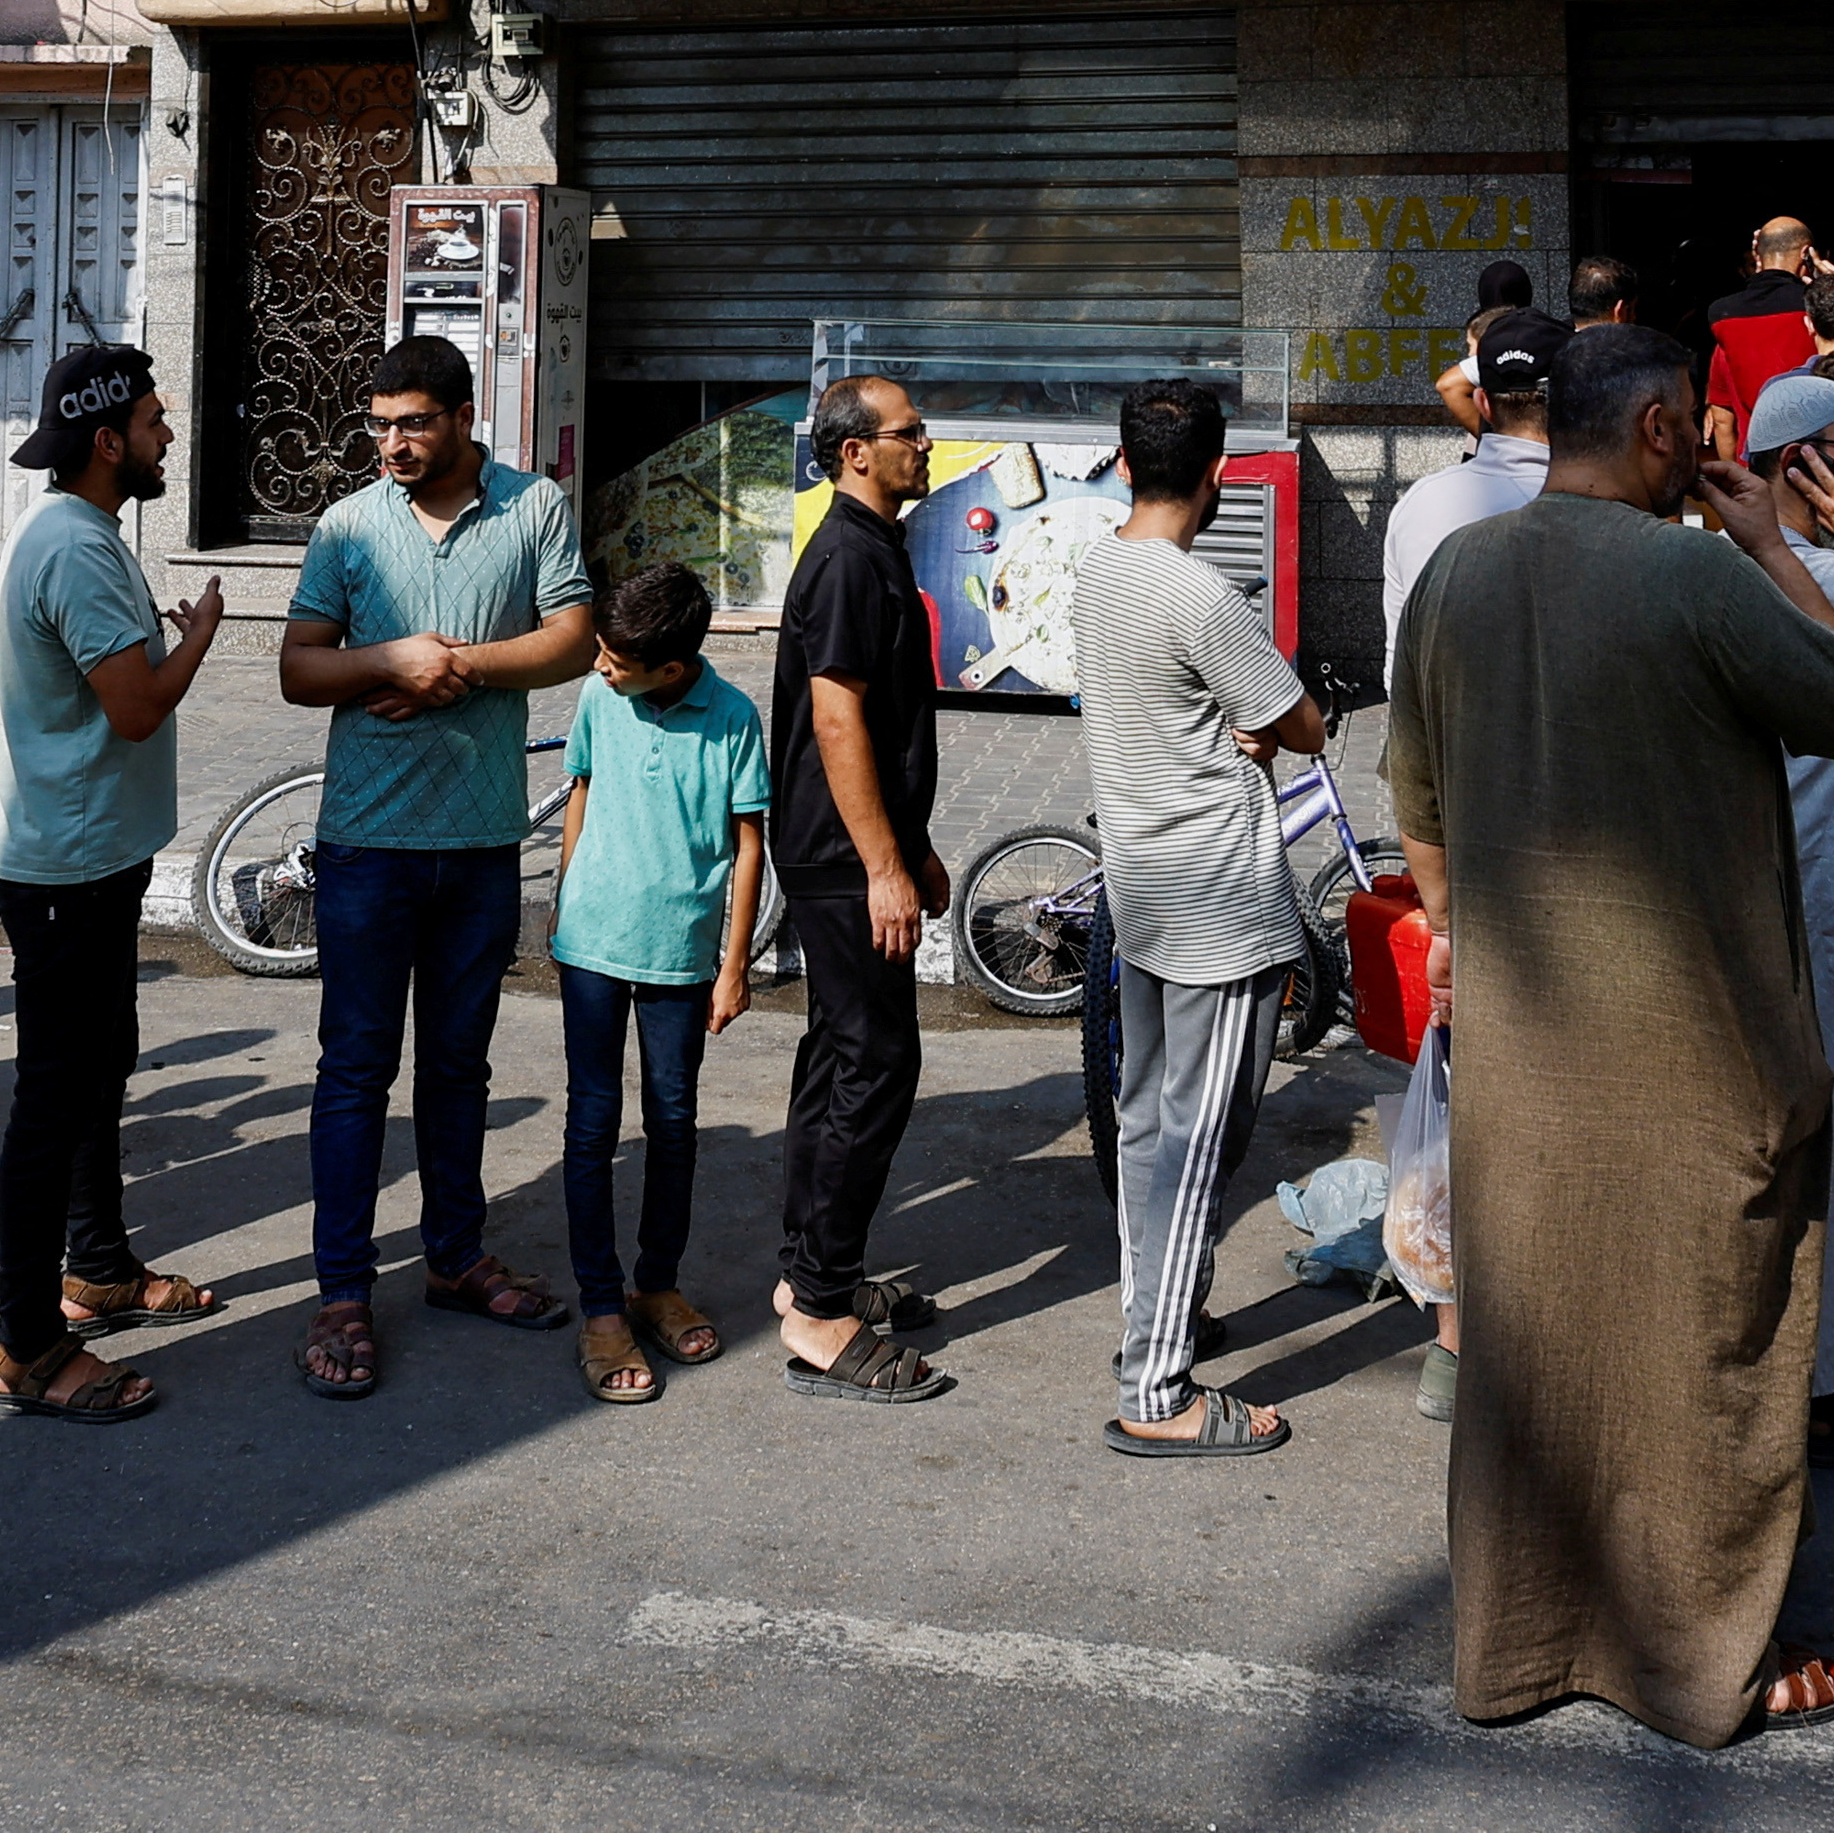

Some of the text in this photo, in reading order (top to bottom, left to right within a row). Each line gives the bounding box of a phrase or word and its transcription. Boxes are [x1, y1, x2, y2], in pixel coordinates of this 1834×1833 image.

[1382, 263, 1428, 316] &
[1496, 348, 1535, 366] adidas
[59, 370, 130, 419] adid
